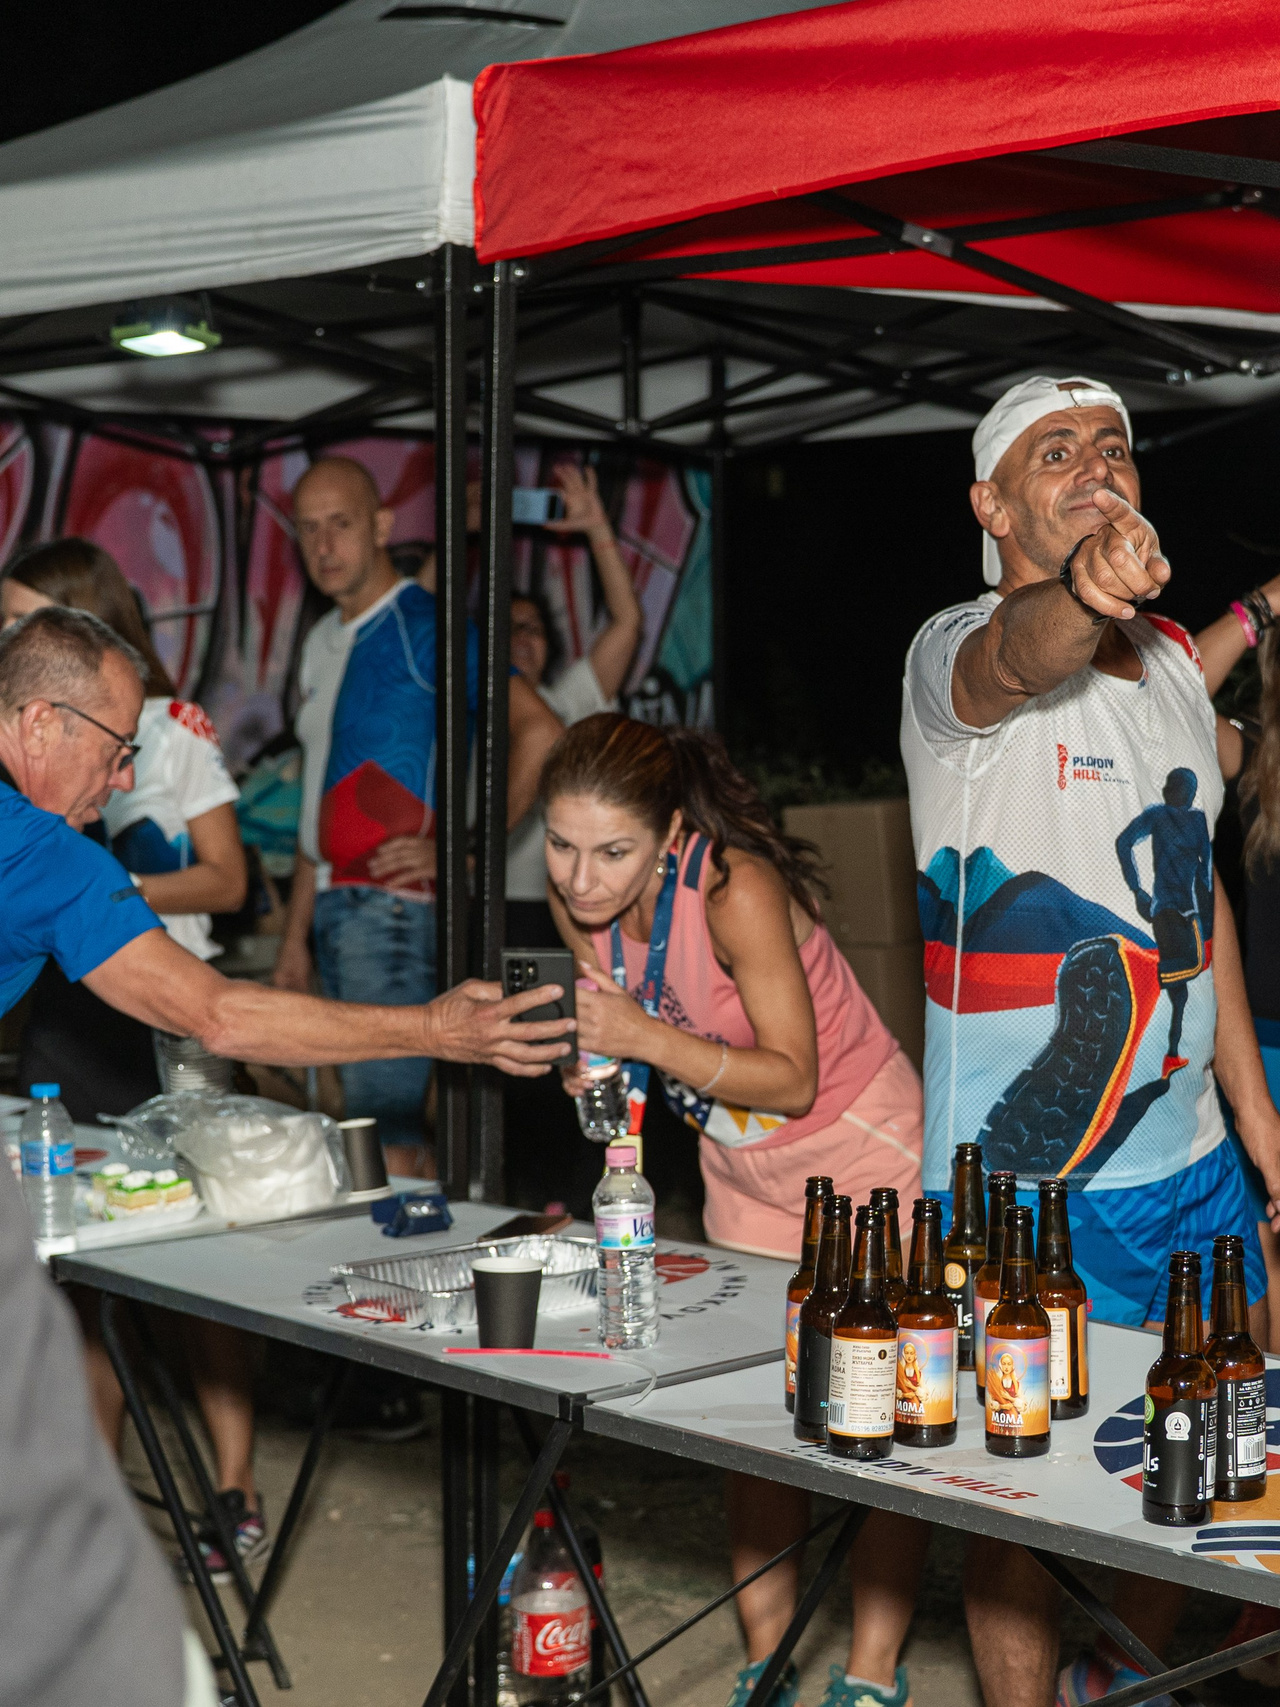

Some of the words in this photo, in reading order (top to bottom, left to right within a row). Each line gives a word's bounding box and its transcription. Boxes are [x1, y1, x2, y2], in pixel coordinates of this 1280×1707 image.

[1073, 756, 1114, 769] PLOVDIV
[633, 1216, 654, 1238] Ves
[992, 1410, 1024, 1425] MOMA
[930, 1475, 1040, 1501] HILLS
